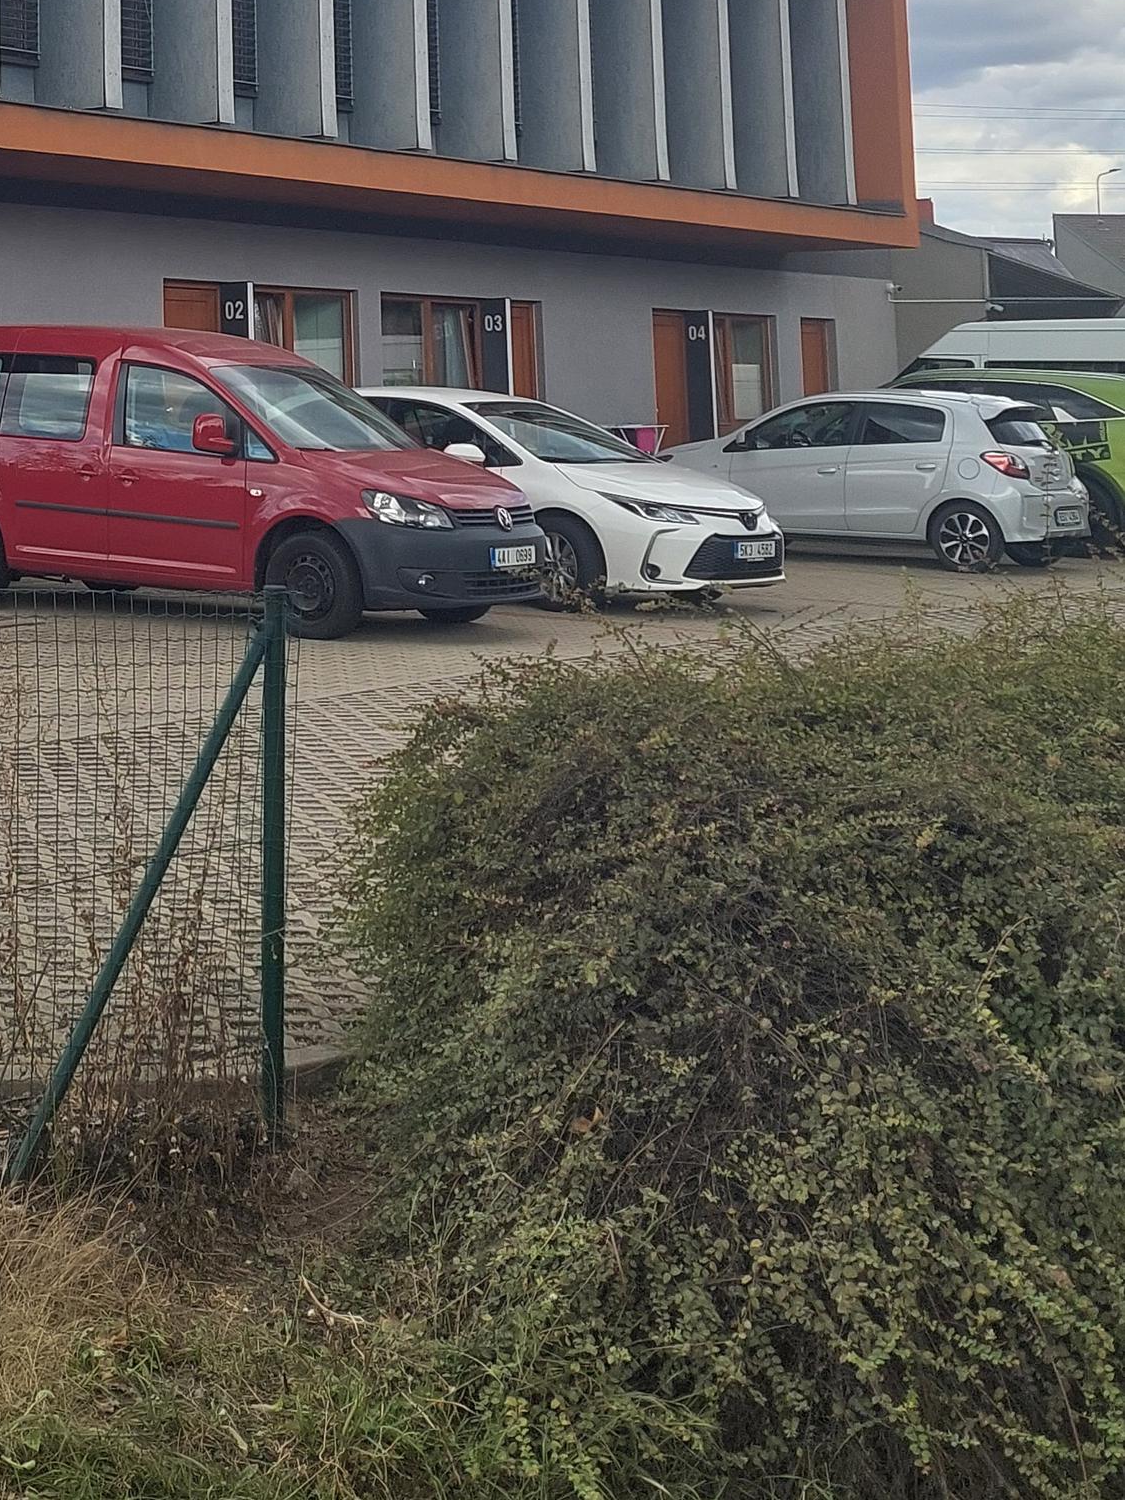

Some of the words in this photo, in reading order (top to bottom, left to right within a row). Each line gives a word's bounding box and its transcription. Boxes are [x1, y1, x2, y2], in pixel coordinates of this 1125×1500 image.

[224, 300, 244, 320] 02
[484, 314, 503, 332] 03
[688, 325, 706, 341] 04
